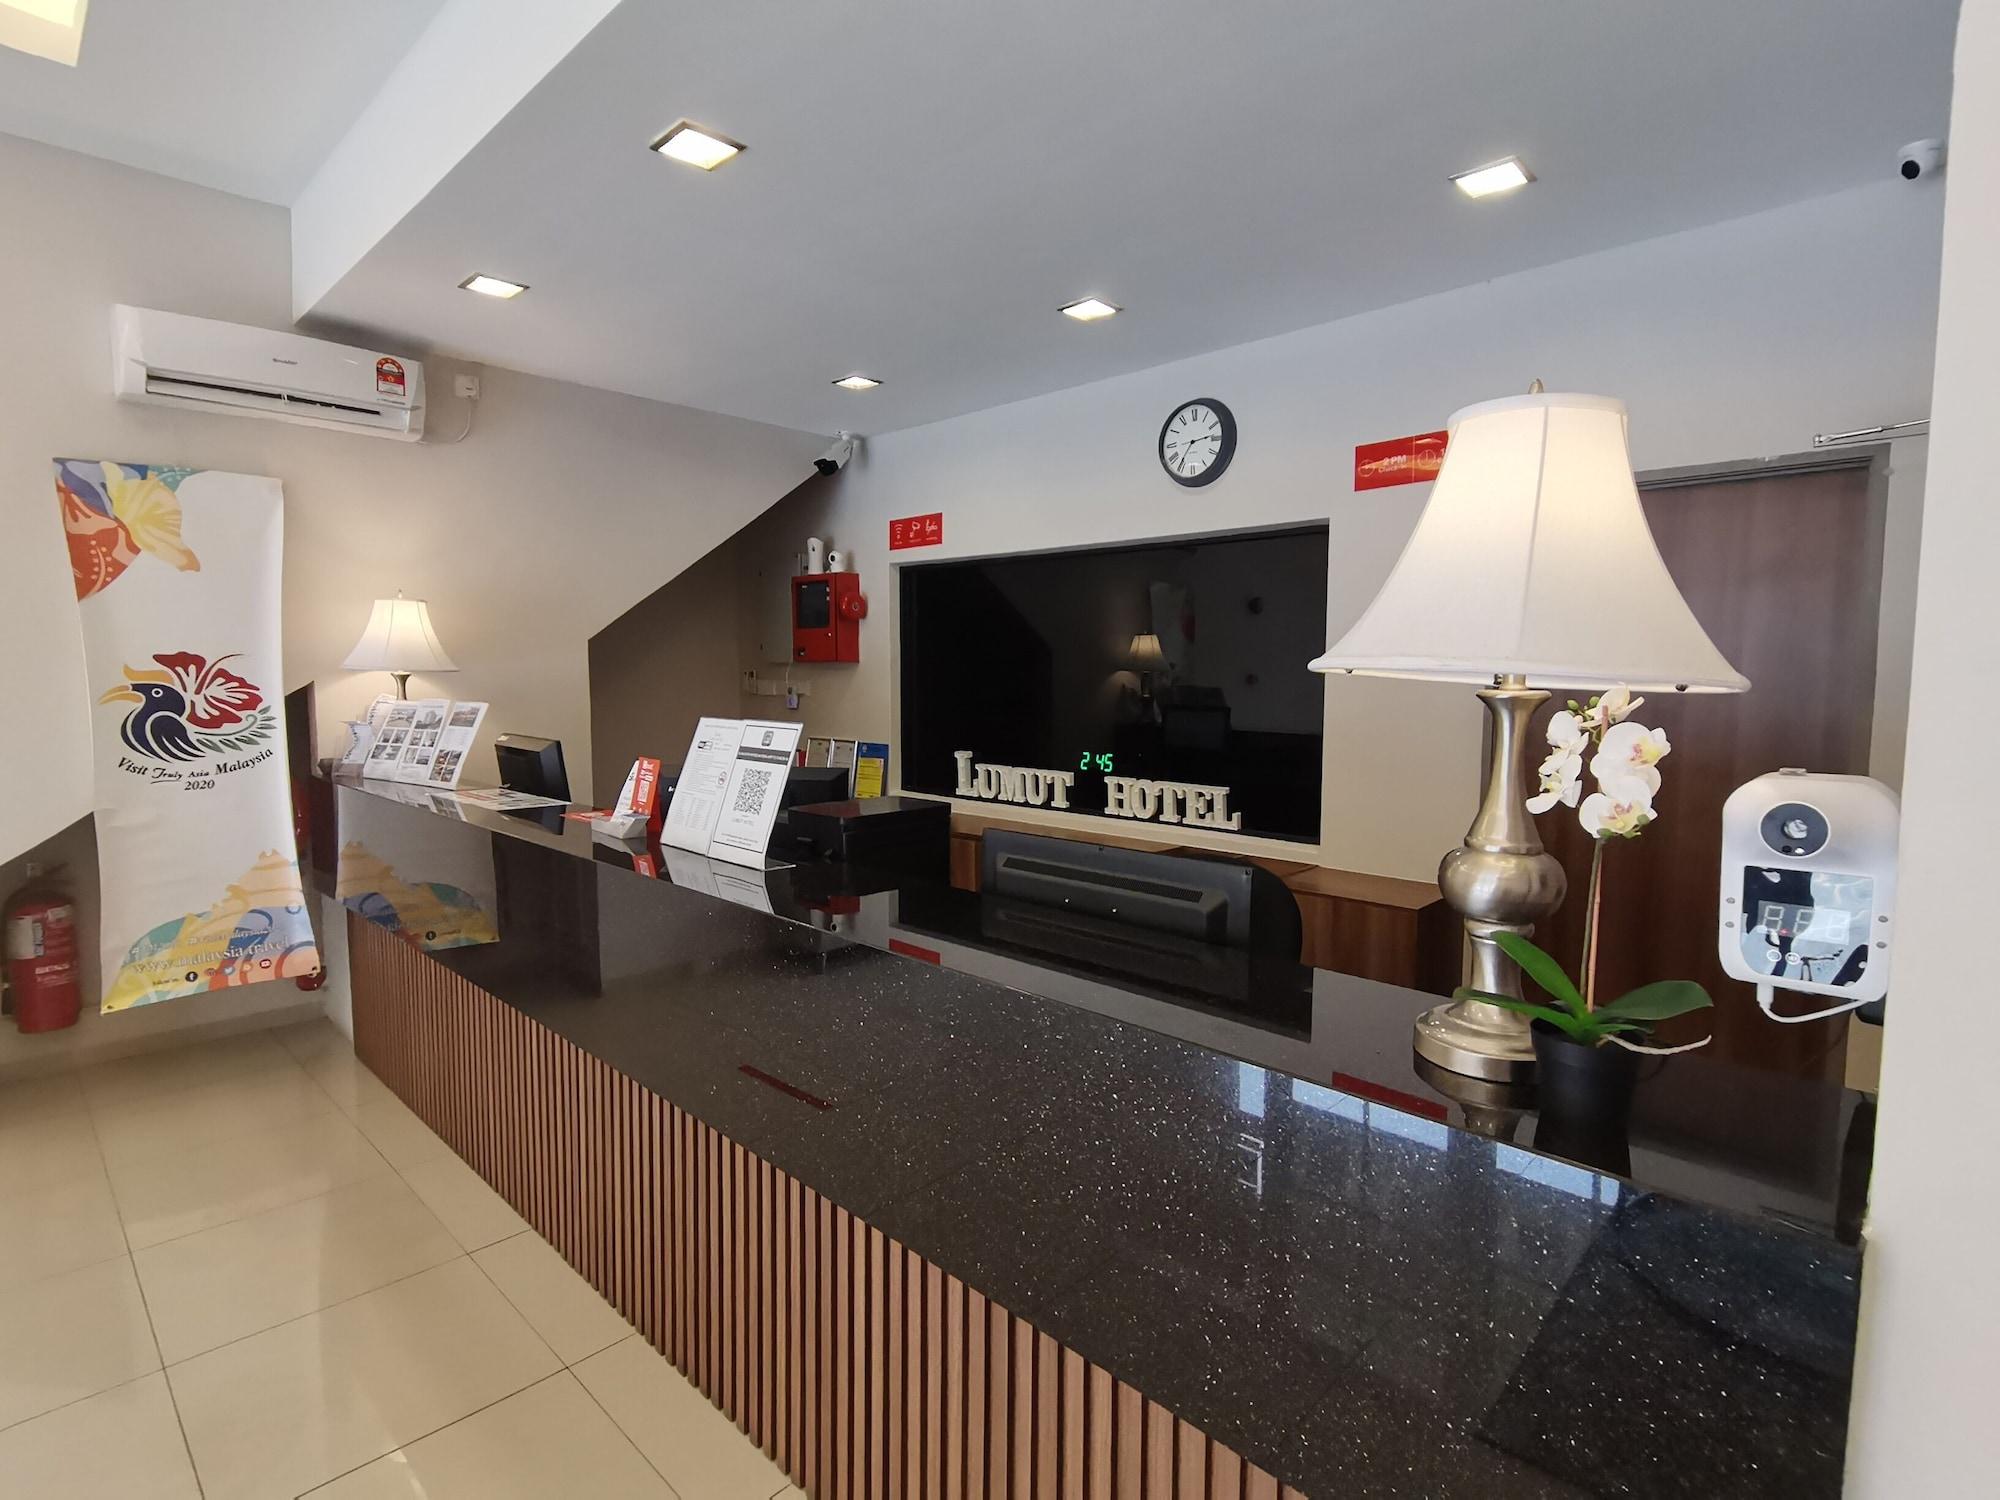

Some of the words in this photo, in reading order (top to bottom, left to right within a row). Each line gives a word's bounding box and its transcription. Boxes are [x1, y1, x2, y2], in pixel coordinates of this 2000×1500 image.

[118, 756, 148, 776] Visit
[151, 767, 183, 784] Truly
[188, 769, 209, 778] Asia
[215, 748, 274, 776] Malaysia
[184, 779, 216, 791] 2020
[953, 750, 1075, 809] LUMUT
[1103, 775, 1242, 832] HOTEL
